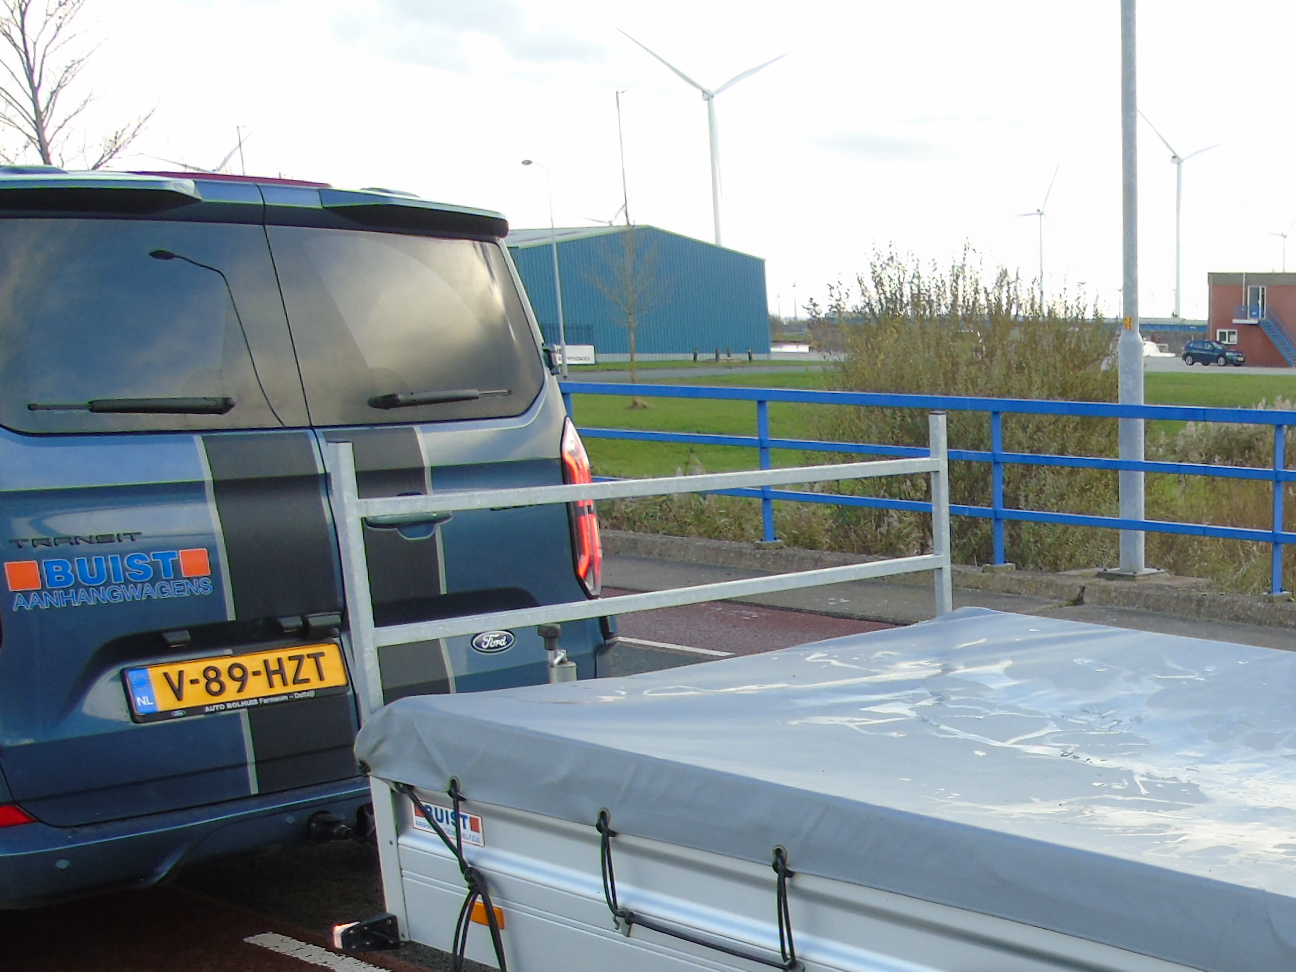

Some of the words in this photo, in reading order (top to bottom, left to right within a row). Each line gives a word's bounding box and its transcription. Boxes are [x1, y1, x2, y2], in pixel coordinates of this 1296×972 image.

[9, 532, 142, 548] TRANSIT
[43, 550, 179, 589] BUIST
[13, 577, 214, 611] AANHANGWAGENS
[481, 633, 508, 649] Ford
[163, 652, 326, 702] V-89-HZT
[136, 695, 155, 707] NL
[205, 703, 225, 713] AUTO
[226, 699, 259, 709] BOLHUIS
